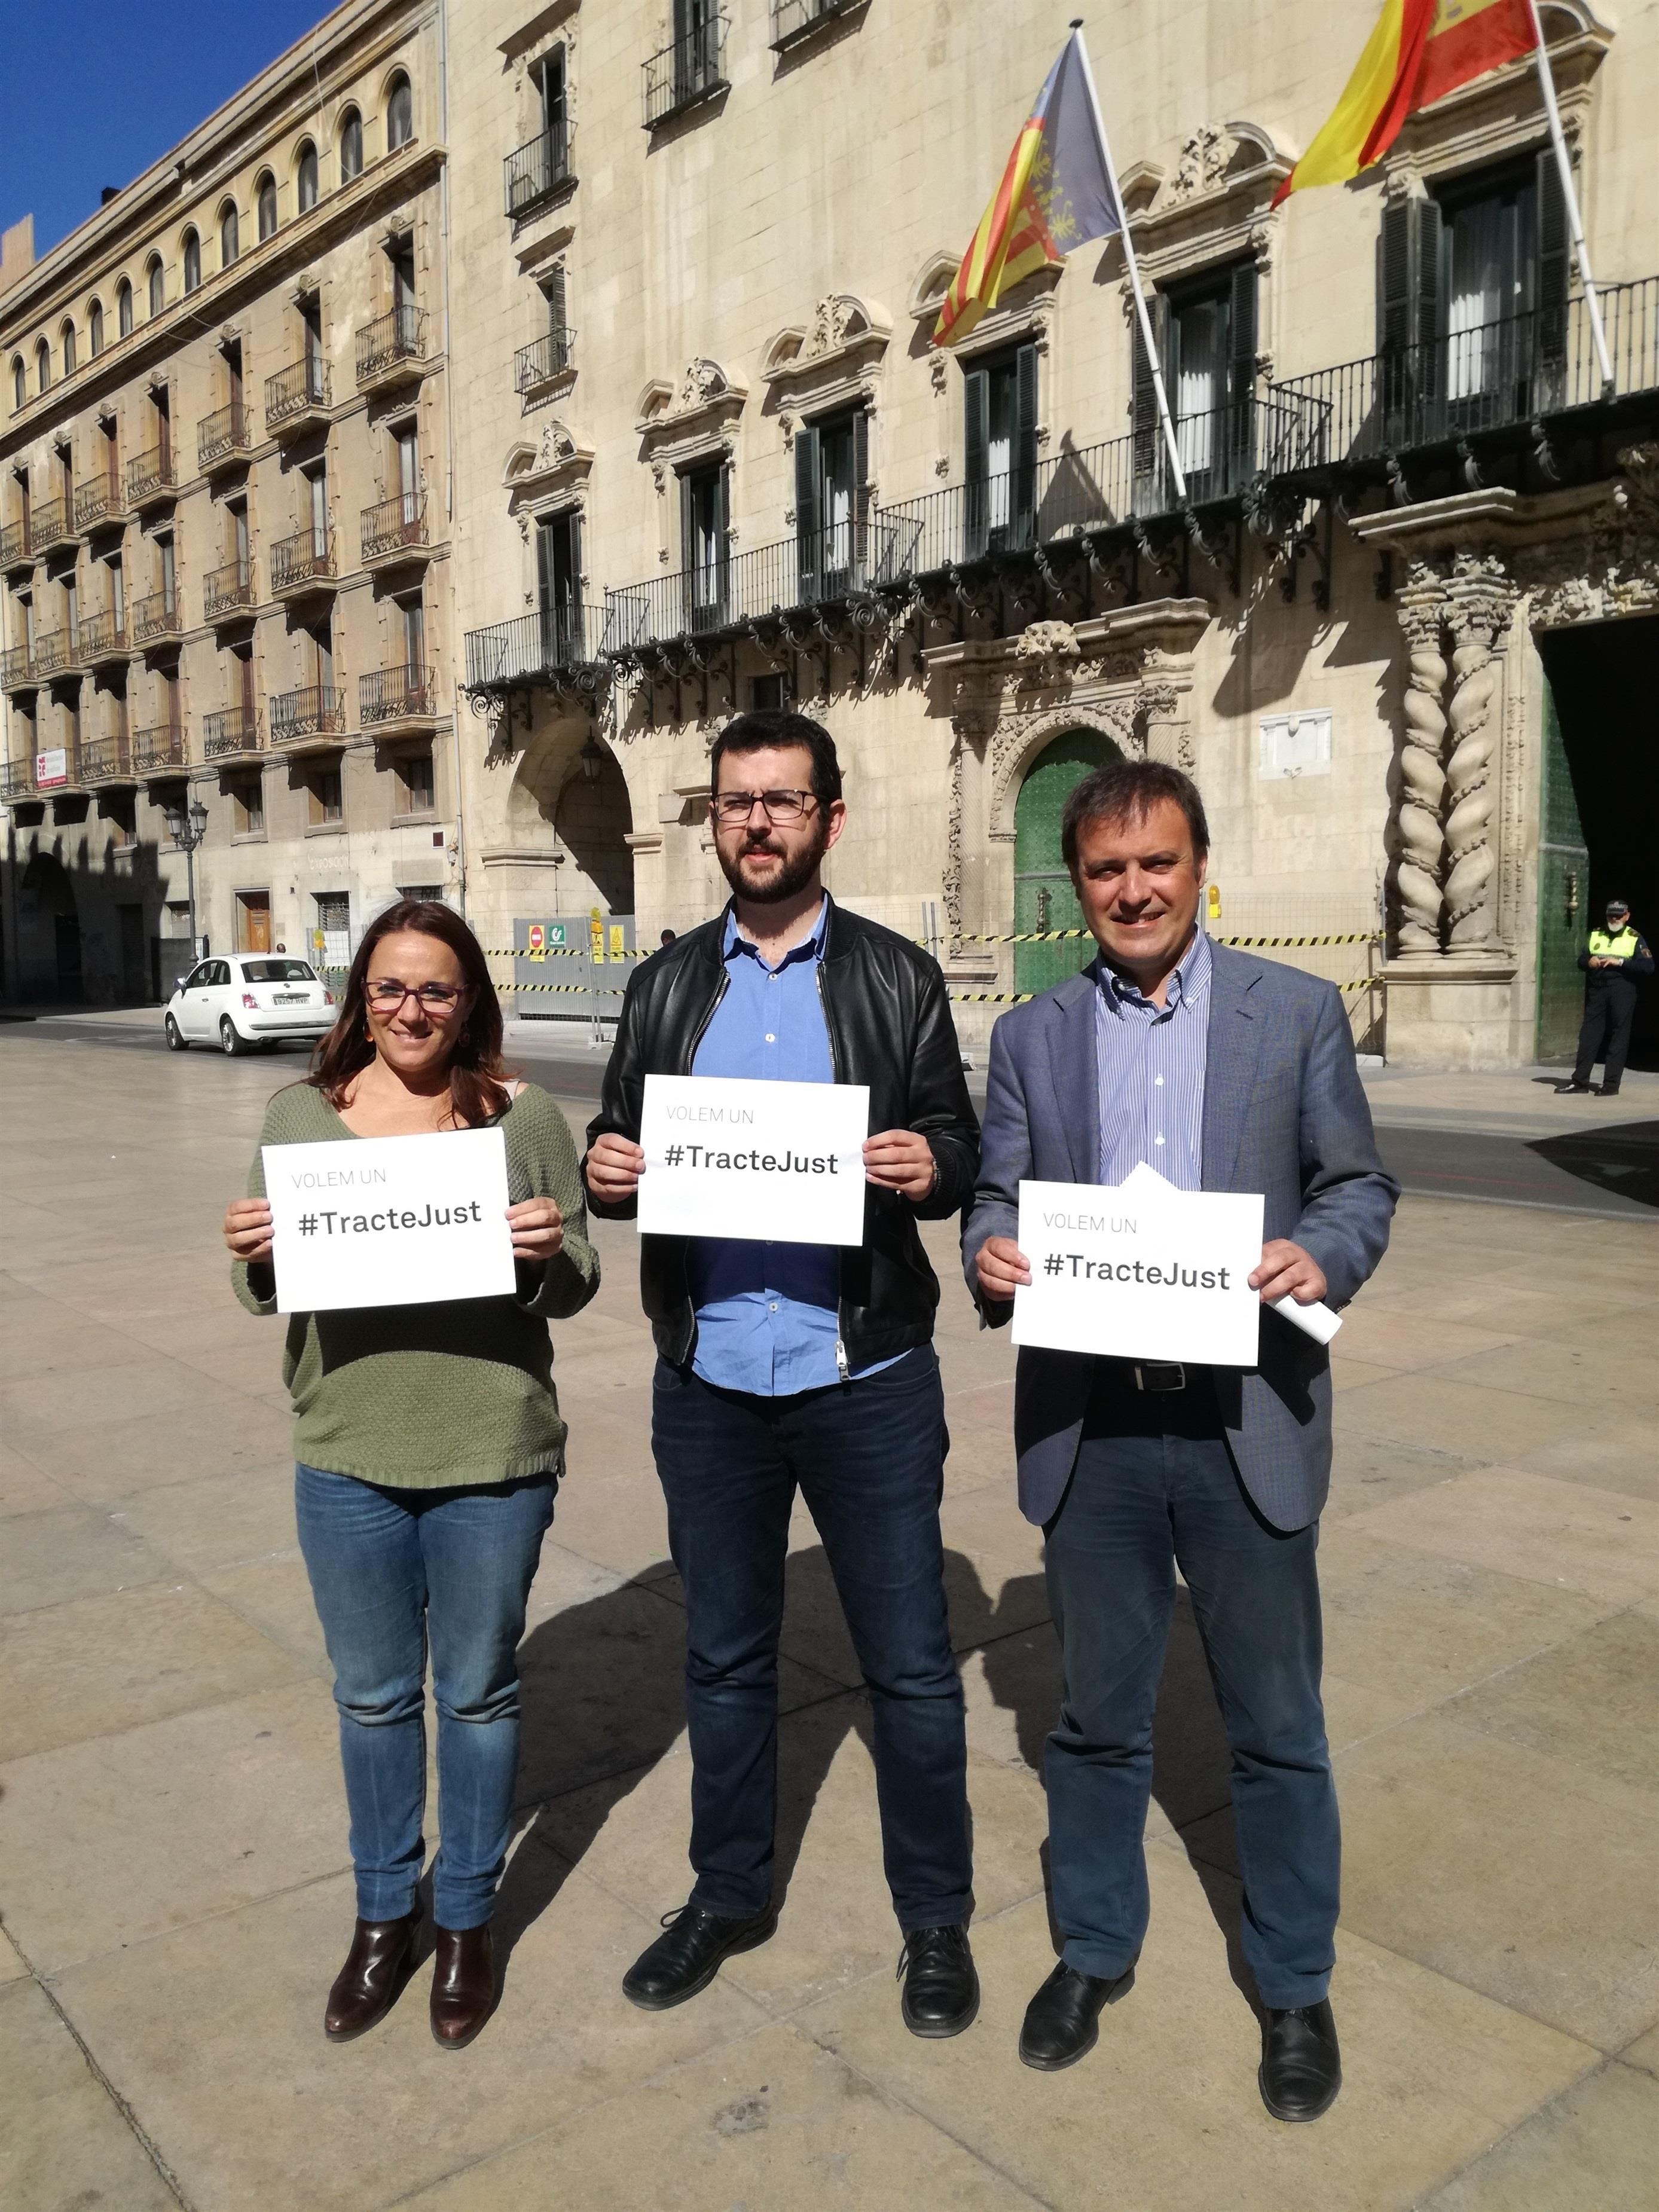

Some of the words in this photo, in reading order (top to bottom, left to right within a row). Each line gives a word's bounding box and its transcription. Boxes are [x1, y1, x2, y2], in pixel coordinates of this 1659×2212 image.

[666, 1105, 723, 1122] VOLEM
[729, 1109, 753, 1124] UN
[665, 1145, 838, 1174] #TracteJust
[291, 1170, 355, 1189] VOLEM
[360, 1168, 386, 1184] UN
[298, 1200, 482, 1236] #TracteJust
[1043, 1212, 1105, 1232] VOLEM
[1111, 1217, 1137, 1234] UN
[1043, 1253, 1230, 1290] #TracteJust
